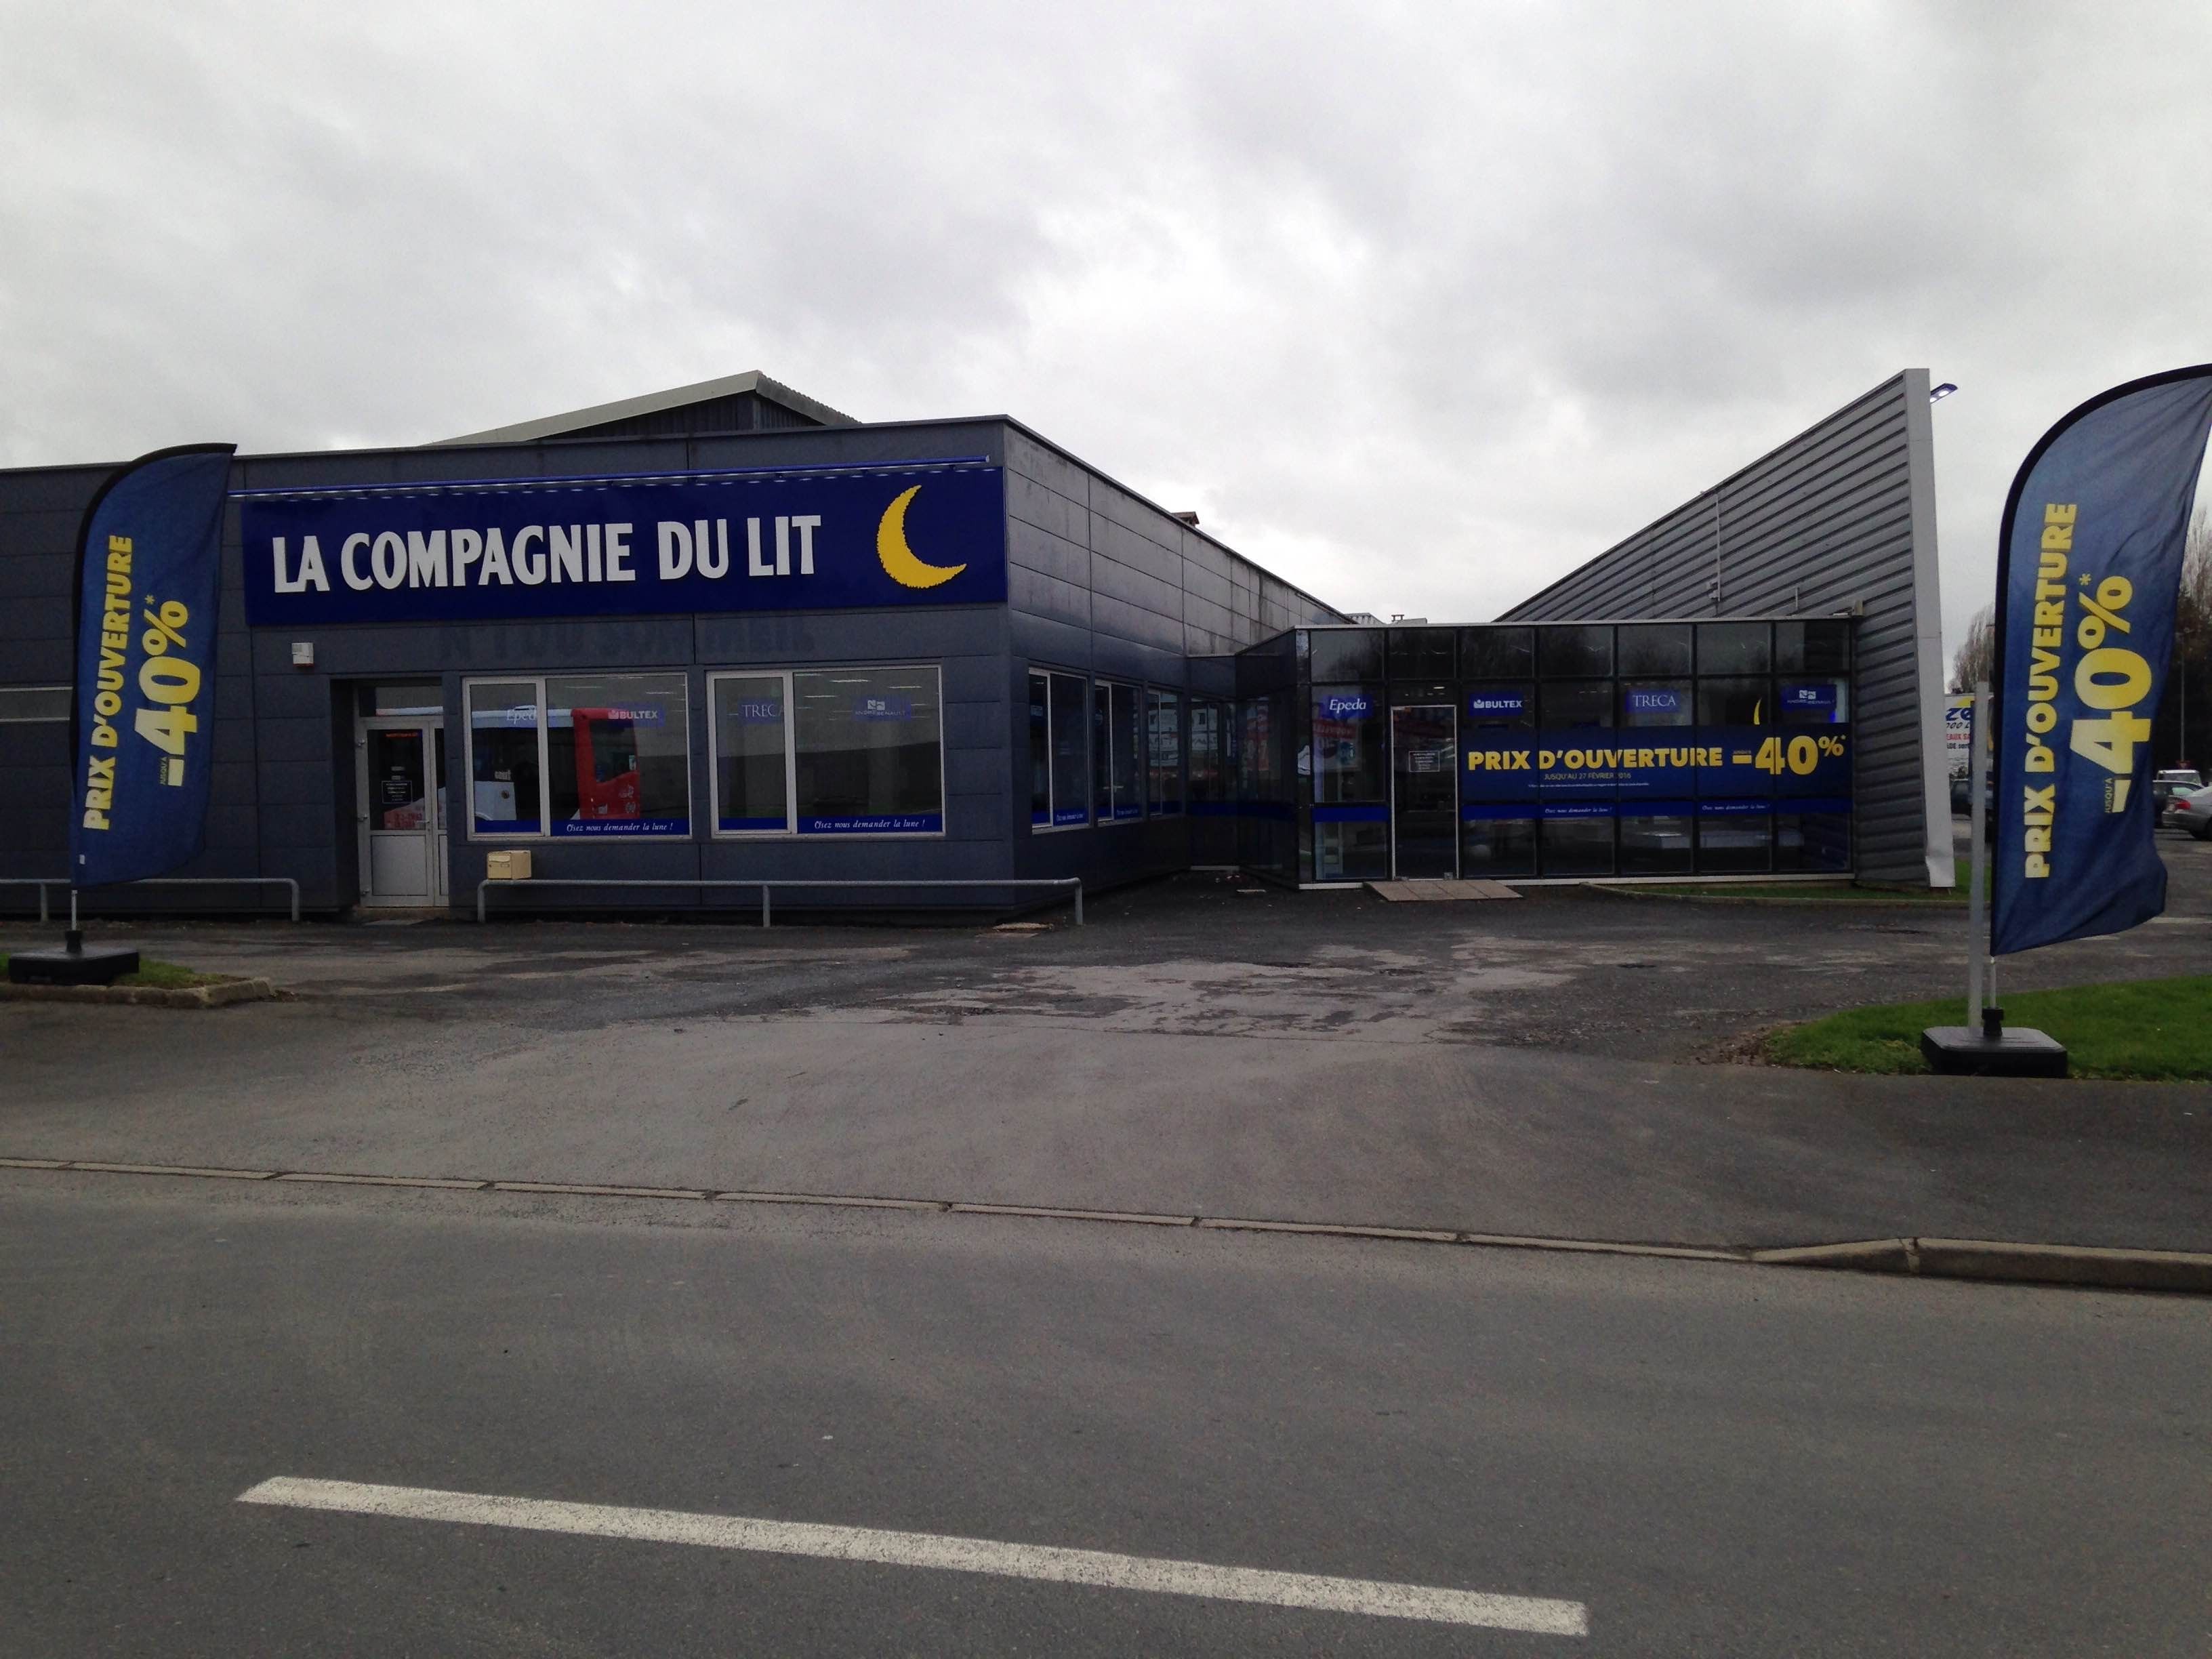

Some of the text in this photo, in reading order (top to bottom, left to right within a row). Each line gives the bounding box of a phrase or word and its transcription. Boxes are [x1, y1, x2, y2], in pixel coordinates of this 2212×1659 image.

[273, 515, 821, 593] LA COMPAGNIE DU LIT
[83, 535, 133, 830] PRIX D'OUVERTURE
[2025, 503, 2077, 878] PRIX D'OUVERTURE
[1329, 698, 1367, 714] Epeda
[1485, 700, 1522, 708] BULTEX
[1632, 695, 1676, 707] TRECA
[507, 708, 538, 725] Eped
[619, 710, 657, 720] BULTEX
[741, 703, 781, 718] TREC
[1468, 751, 1530, 770] PRIX
[1539, 747, 1723, 770] D'OUVERTURE
[567, 823, 583, 832] Osez
[603, 823, 640, 831] demander
[642, 822, 649, 830] la
[652, 822, 668, 830] lune
[815, 821, 832, 829] Osez
[853, 819, 892, 828] demander
[893, 819, 901, 827] la
[903, 819, 920, 827] lune
